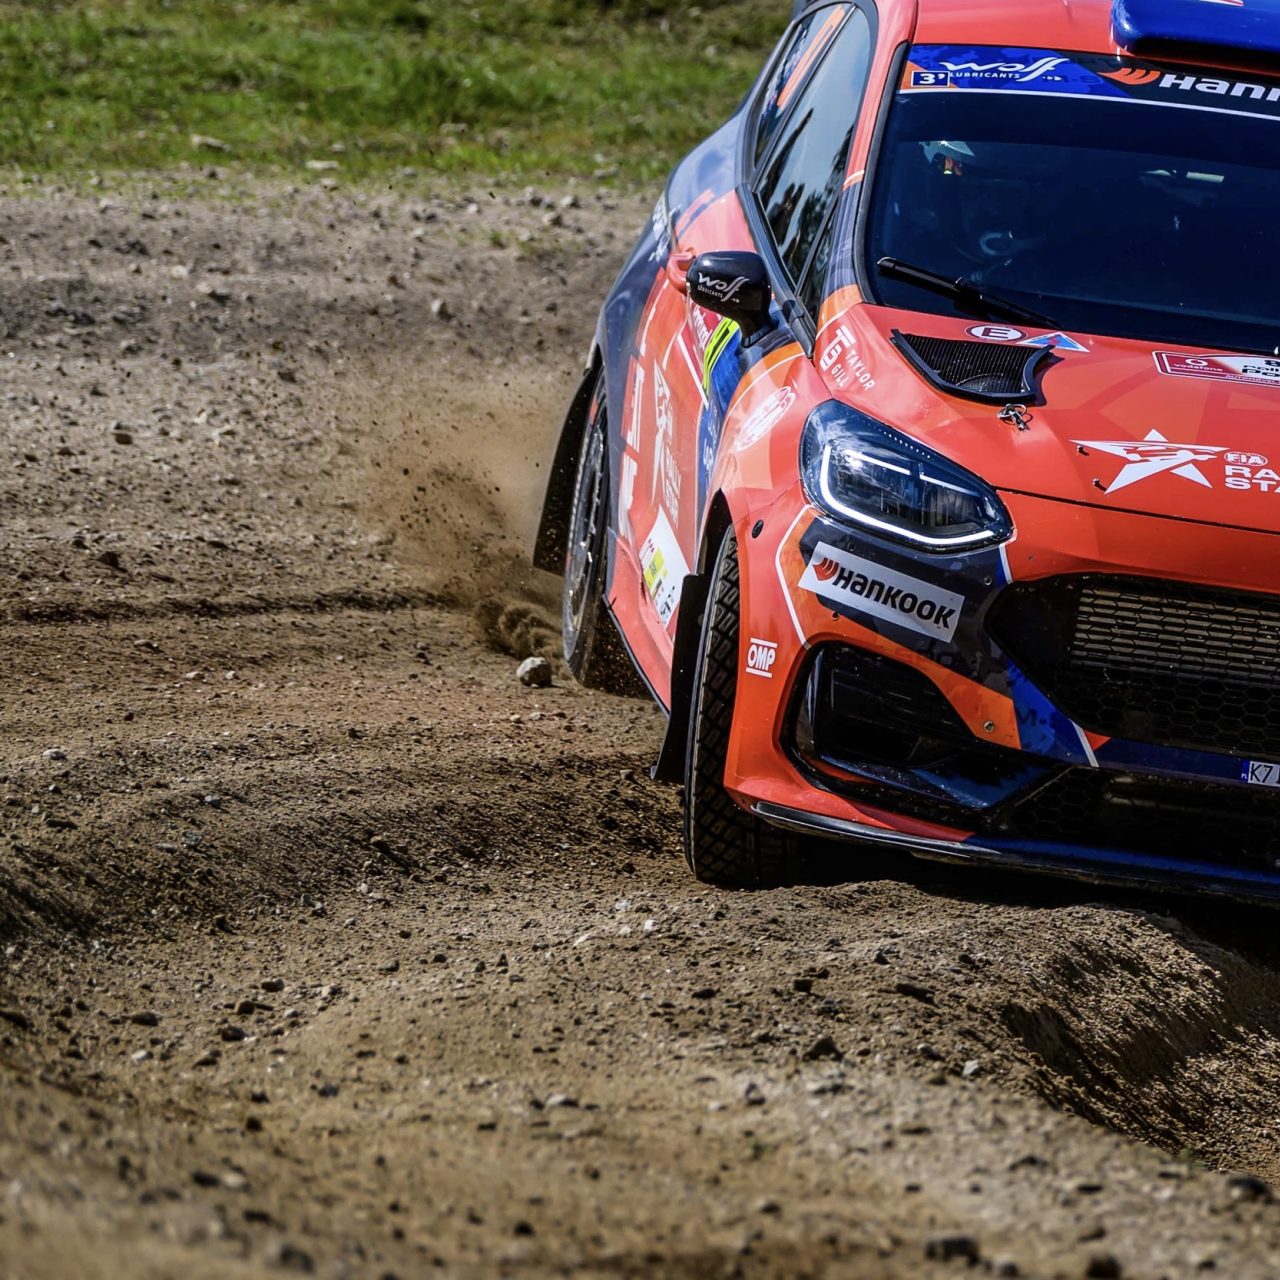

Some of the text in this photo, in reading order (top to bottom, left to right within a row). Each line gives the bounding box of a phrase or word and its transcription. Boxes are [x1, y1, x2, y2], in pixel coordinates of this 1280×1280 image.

[950, 71, 1020, 79] LUBRICANTS
[831, 363, 849, 387] GILL
[845, 349, 876, 391] TAYLOR
[1227, 453, 1264, 465] FIA
[748, 644, 776, 671] OMP
[1250, 763, 1273, 783] K7
